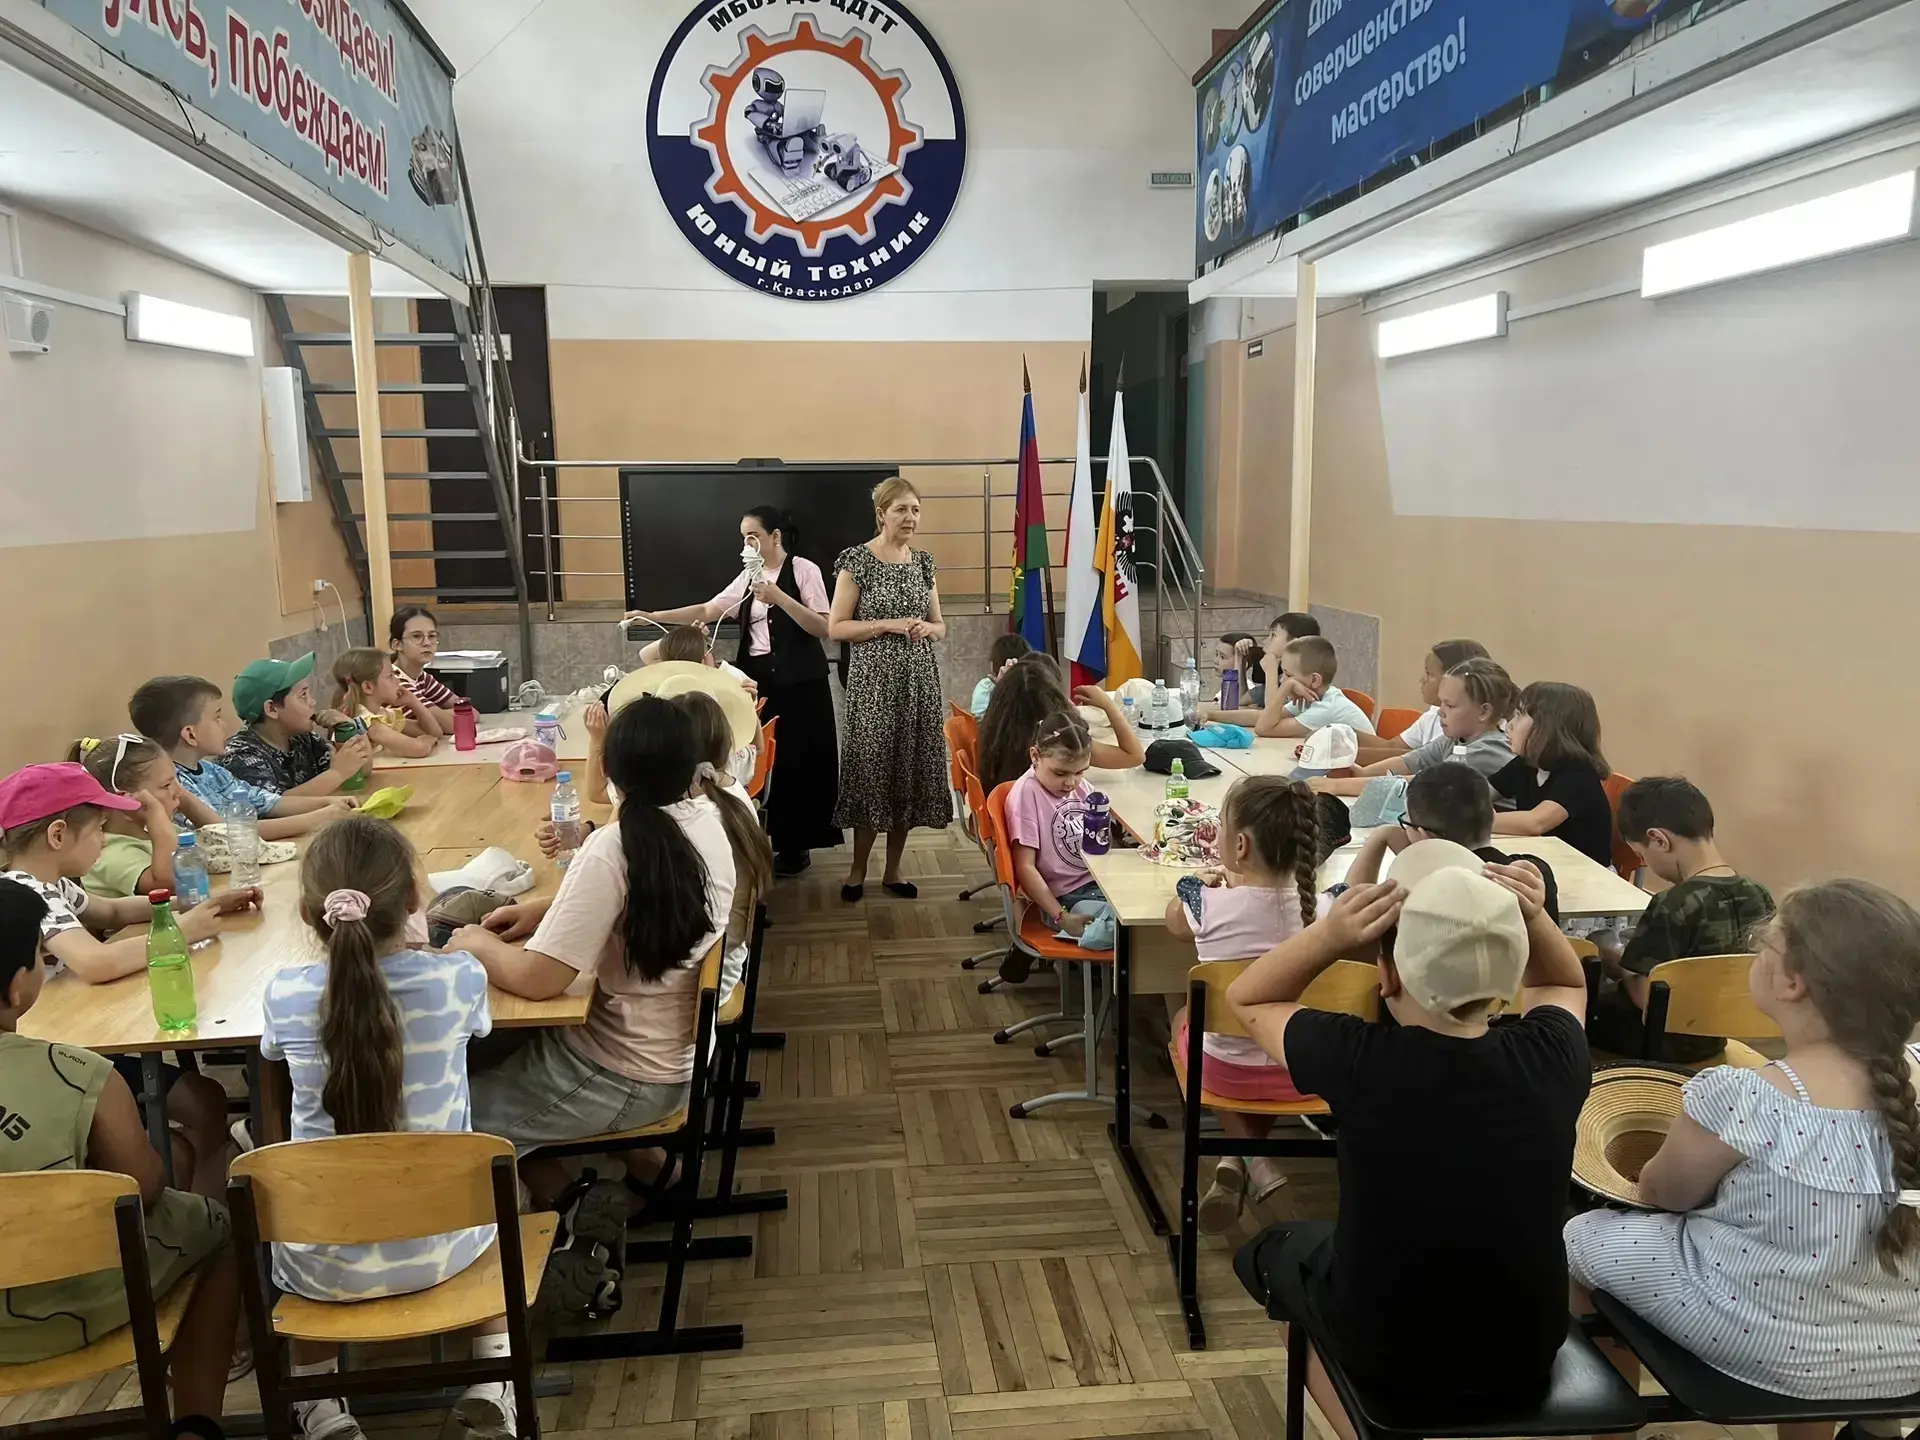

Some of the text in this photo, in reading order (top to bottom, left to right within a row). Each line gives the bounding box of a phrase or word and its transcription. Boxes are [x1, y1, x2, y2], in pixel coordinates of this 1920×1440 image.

[228, 14, 389, 196] побеждаем!
[1331, 16, 1467, 145] мастерство!
[685, 203, 791, 279] Юный
